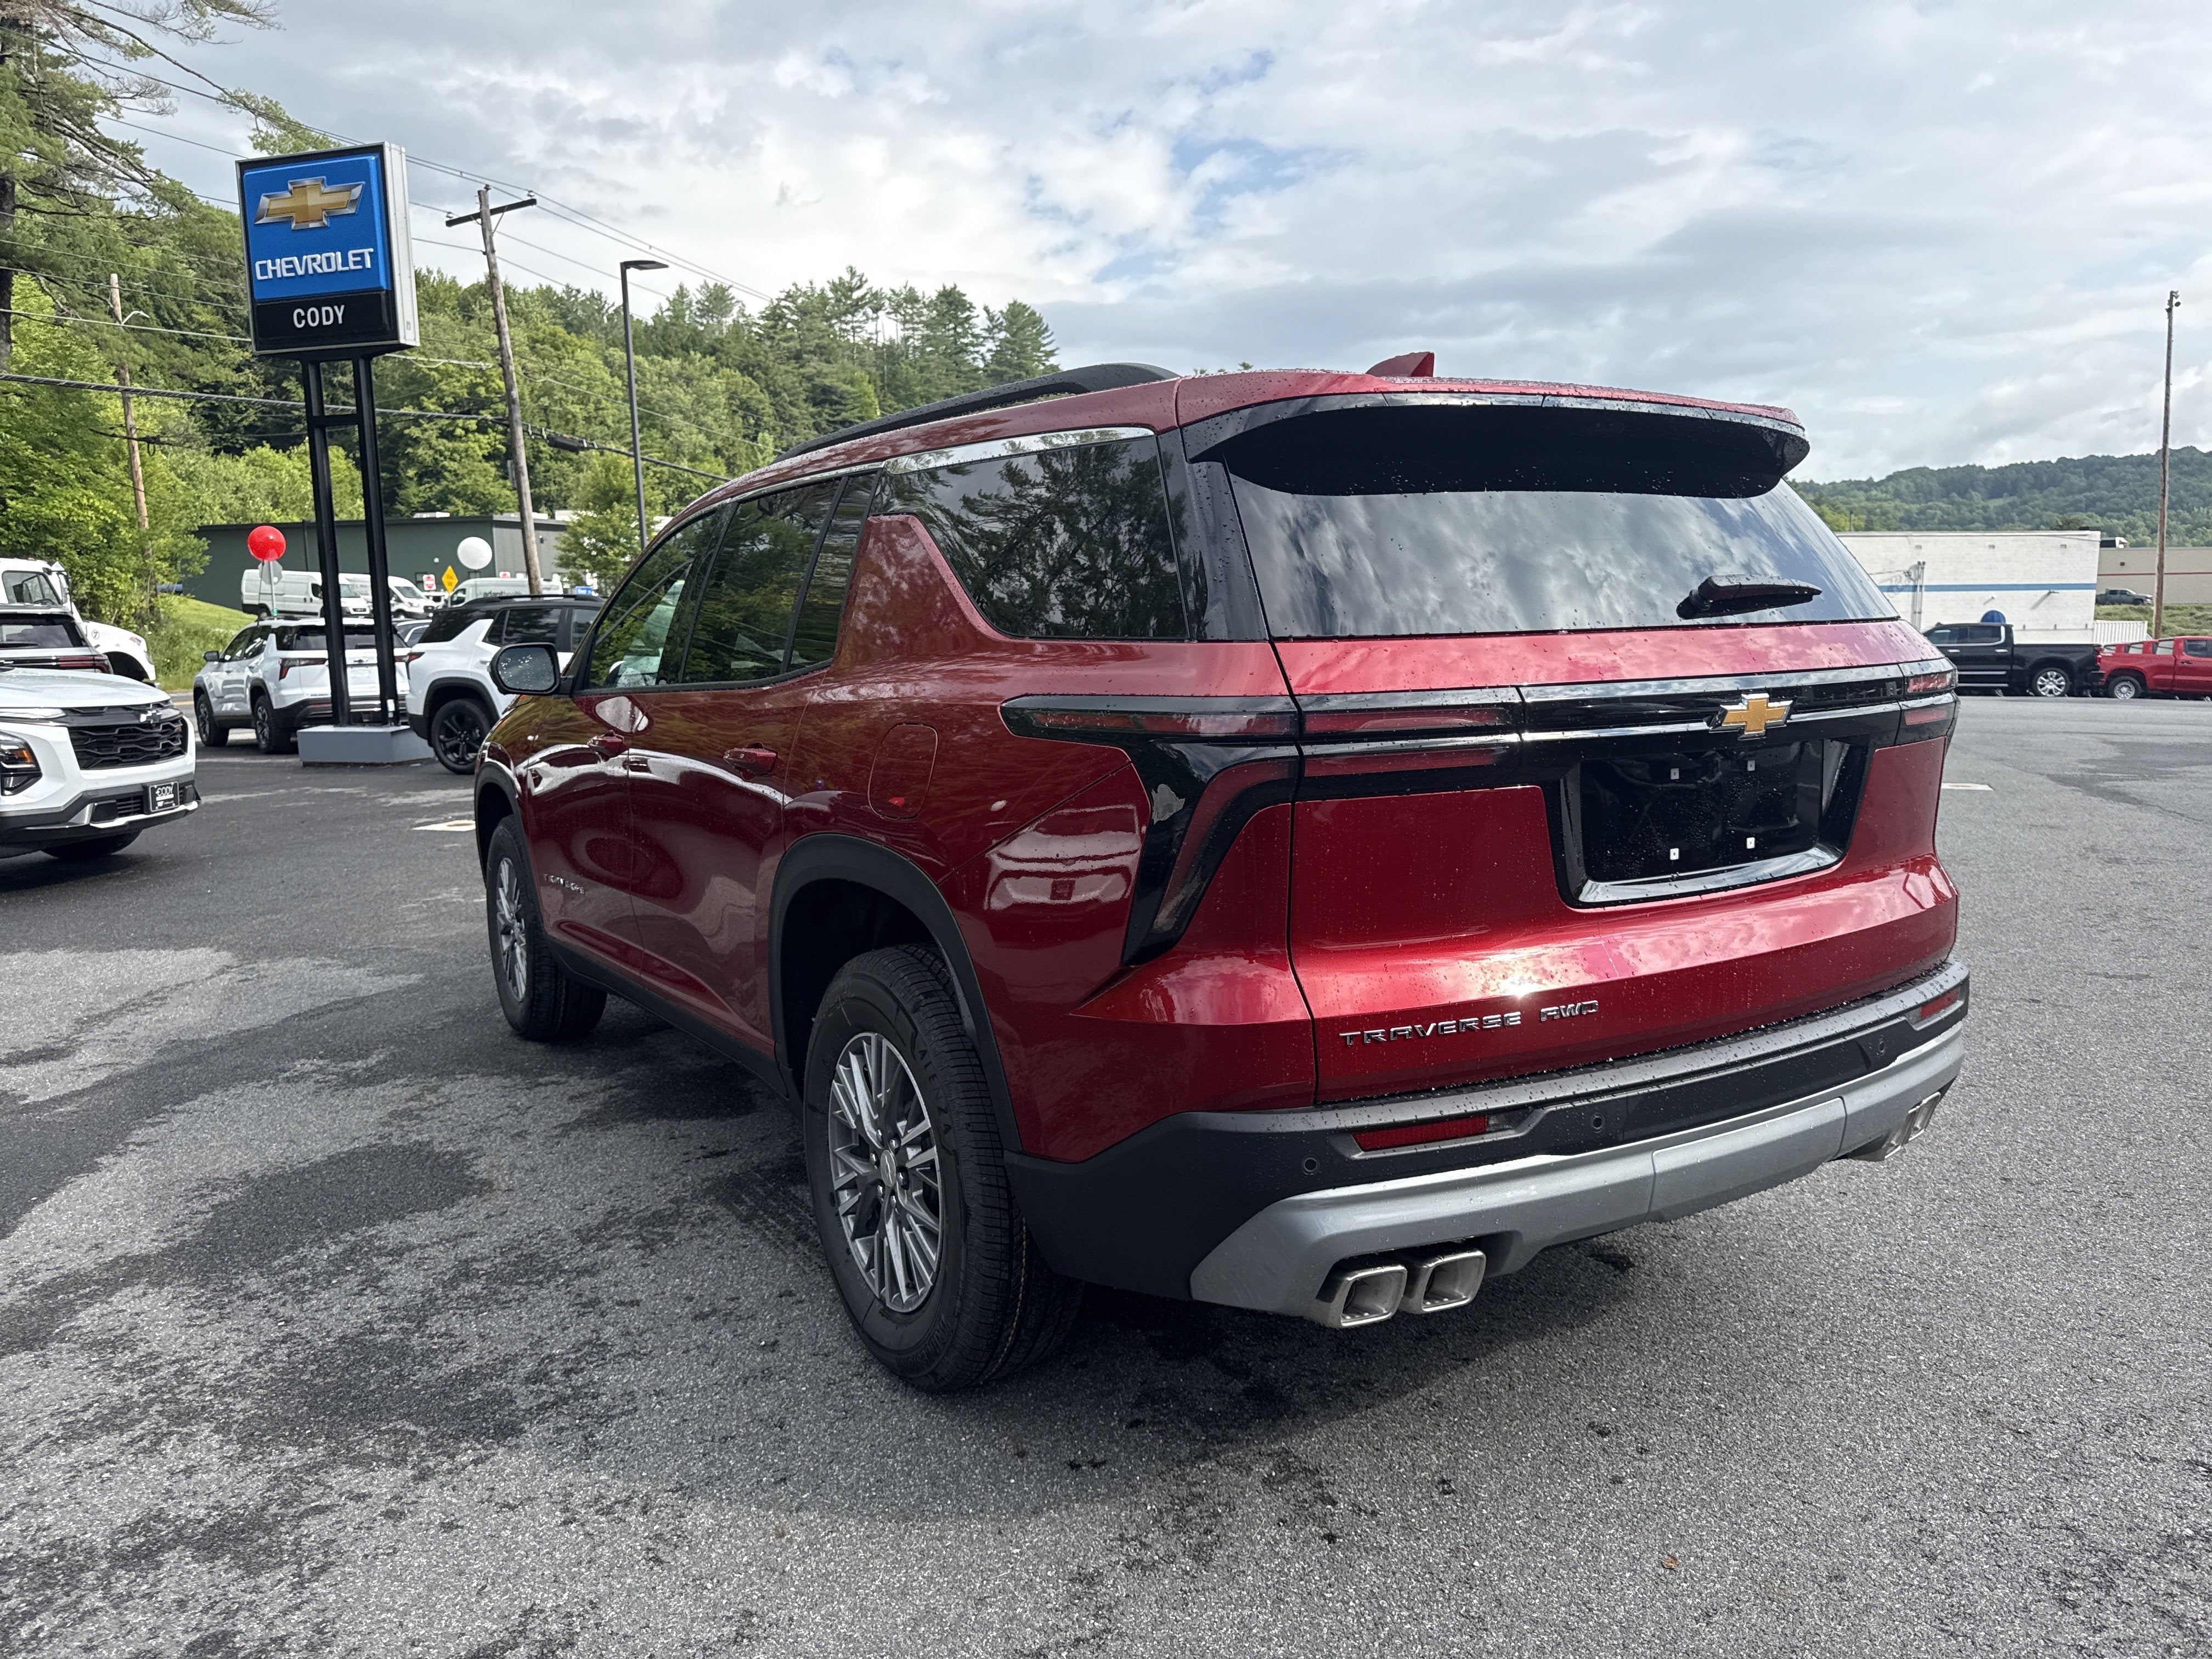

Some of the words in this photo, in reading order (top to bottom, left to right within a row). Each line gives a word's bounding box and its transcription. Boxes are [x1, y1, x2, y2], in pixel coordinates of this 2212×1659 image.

[255, 248, 374, 280] CHEVROLET
[293, 305, 345, 329] CODY
[156, 786, 173, 797] CODY
[1339, 1011, 1521, 1046] TRAVERSE
[1541, 1000, 1599, 1022] AWD
[918, 1049, 952, 1135] ALENZA
